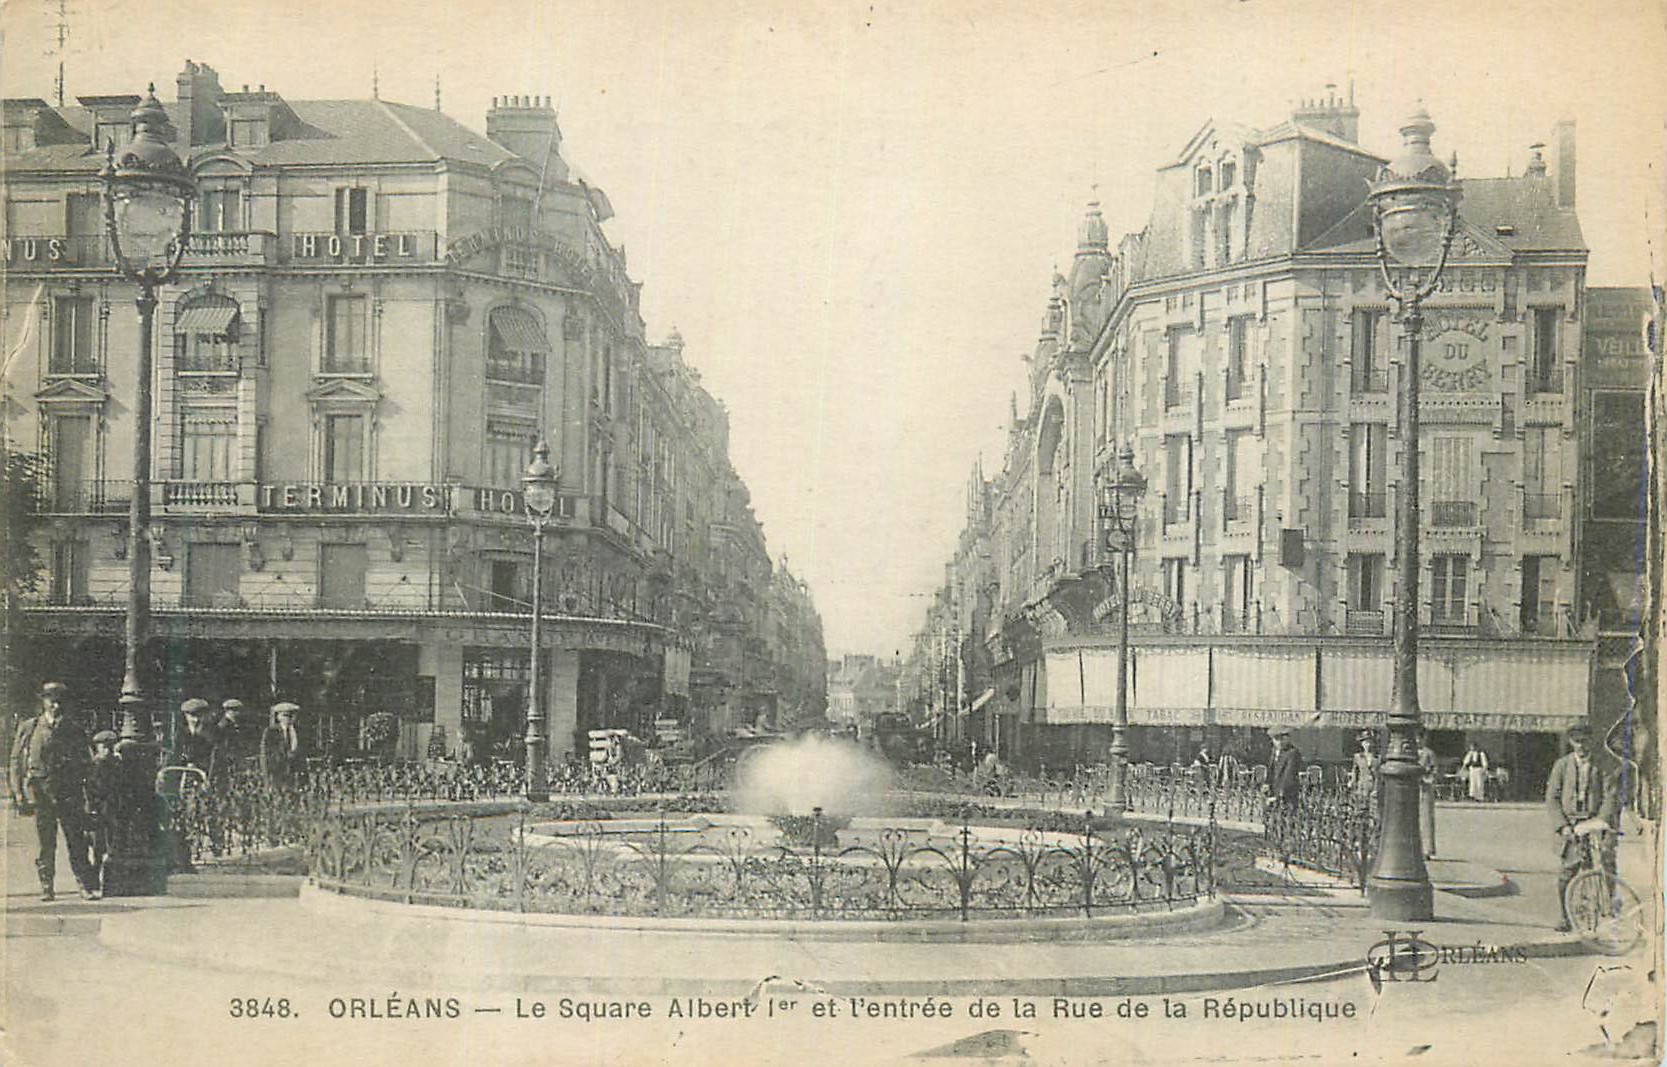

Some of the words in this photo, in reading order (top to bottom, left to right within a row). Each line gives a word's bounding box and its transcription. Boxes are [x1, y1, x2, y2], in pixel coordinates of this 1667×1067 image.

[302, 234, 410, 257] HOTEL
[1423, 317, 1489, 342] HOTEL
[1443, 343, 1469, 360] DU
[1421, 359, 1492, 391] BERRY
[262, 484, 437, 509] TERMINUS
[481, 489, 571, 518] HOL
